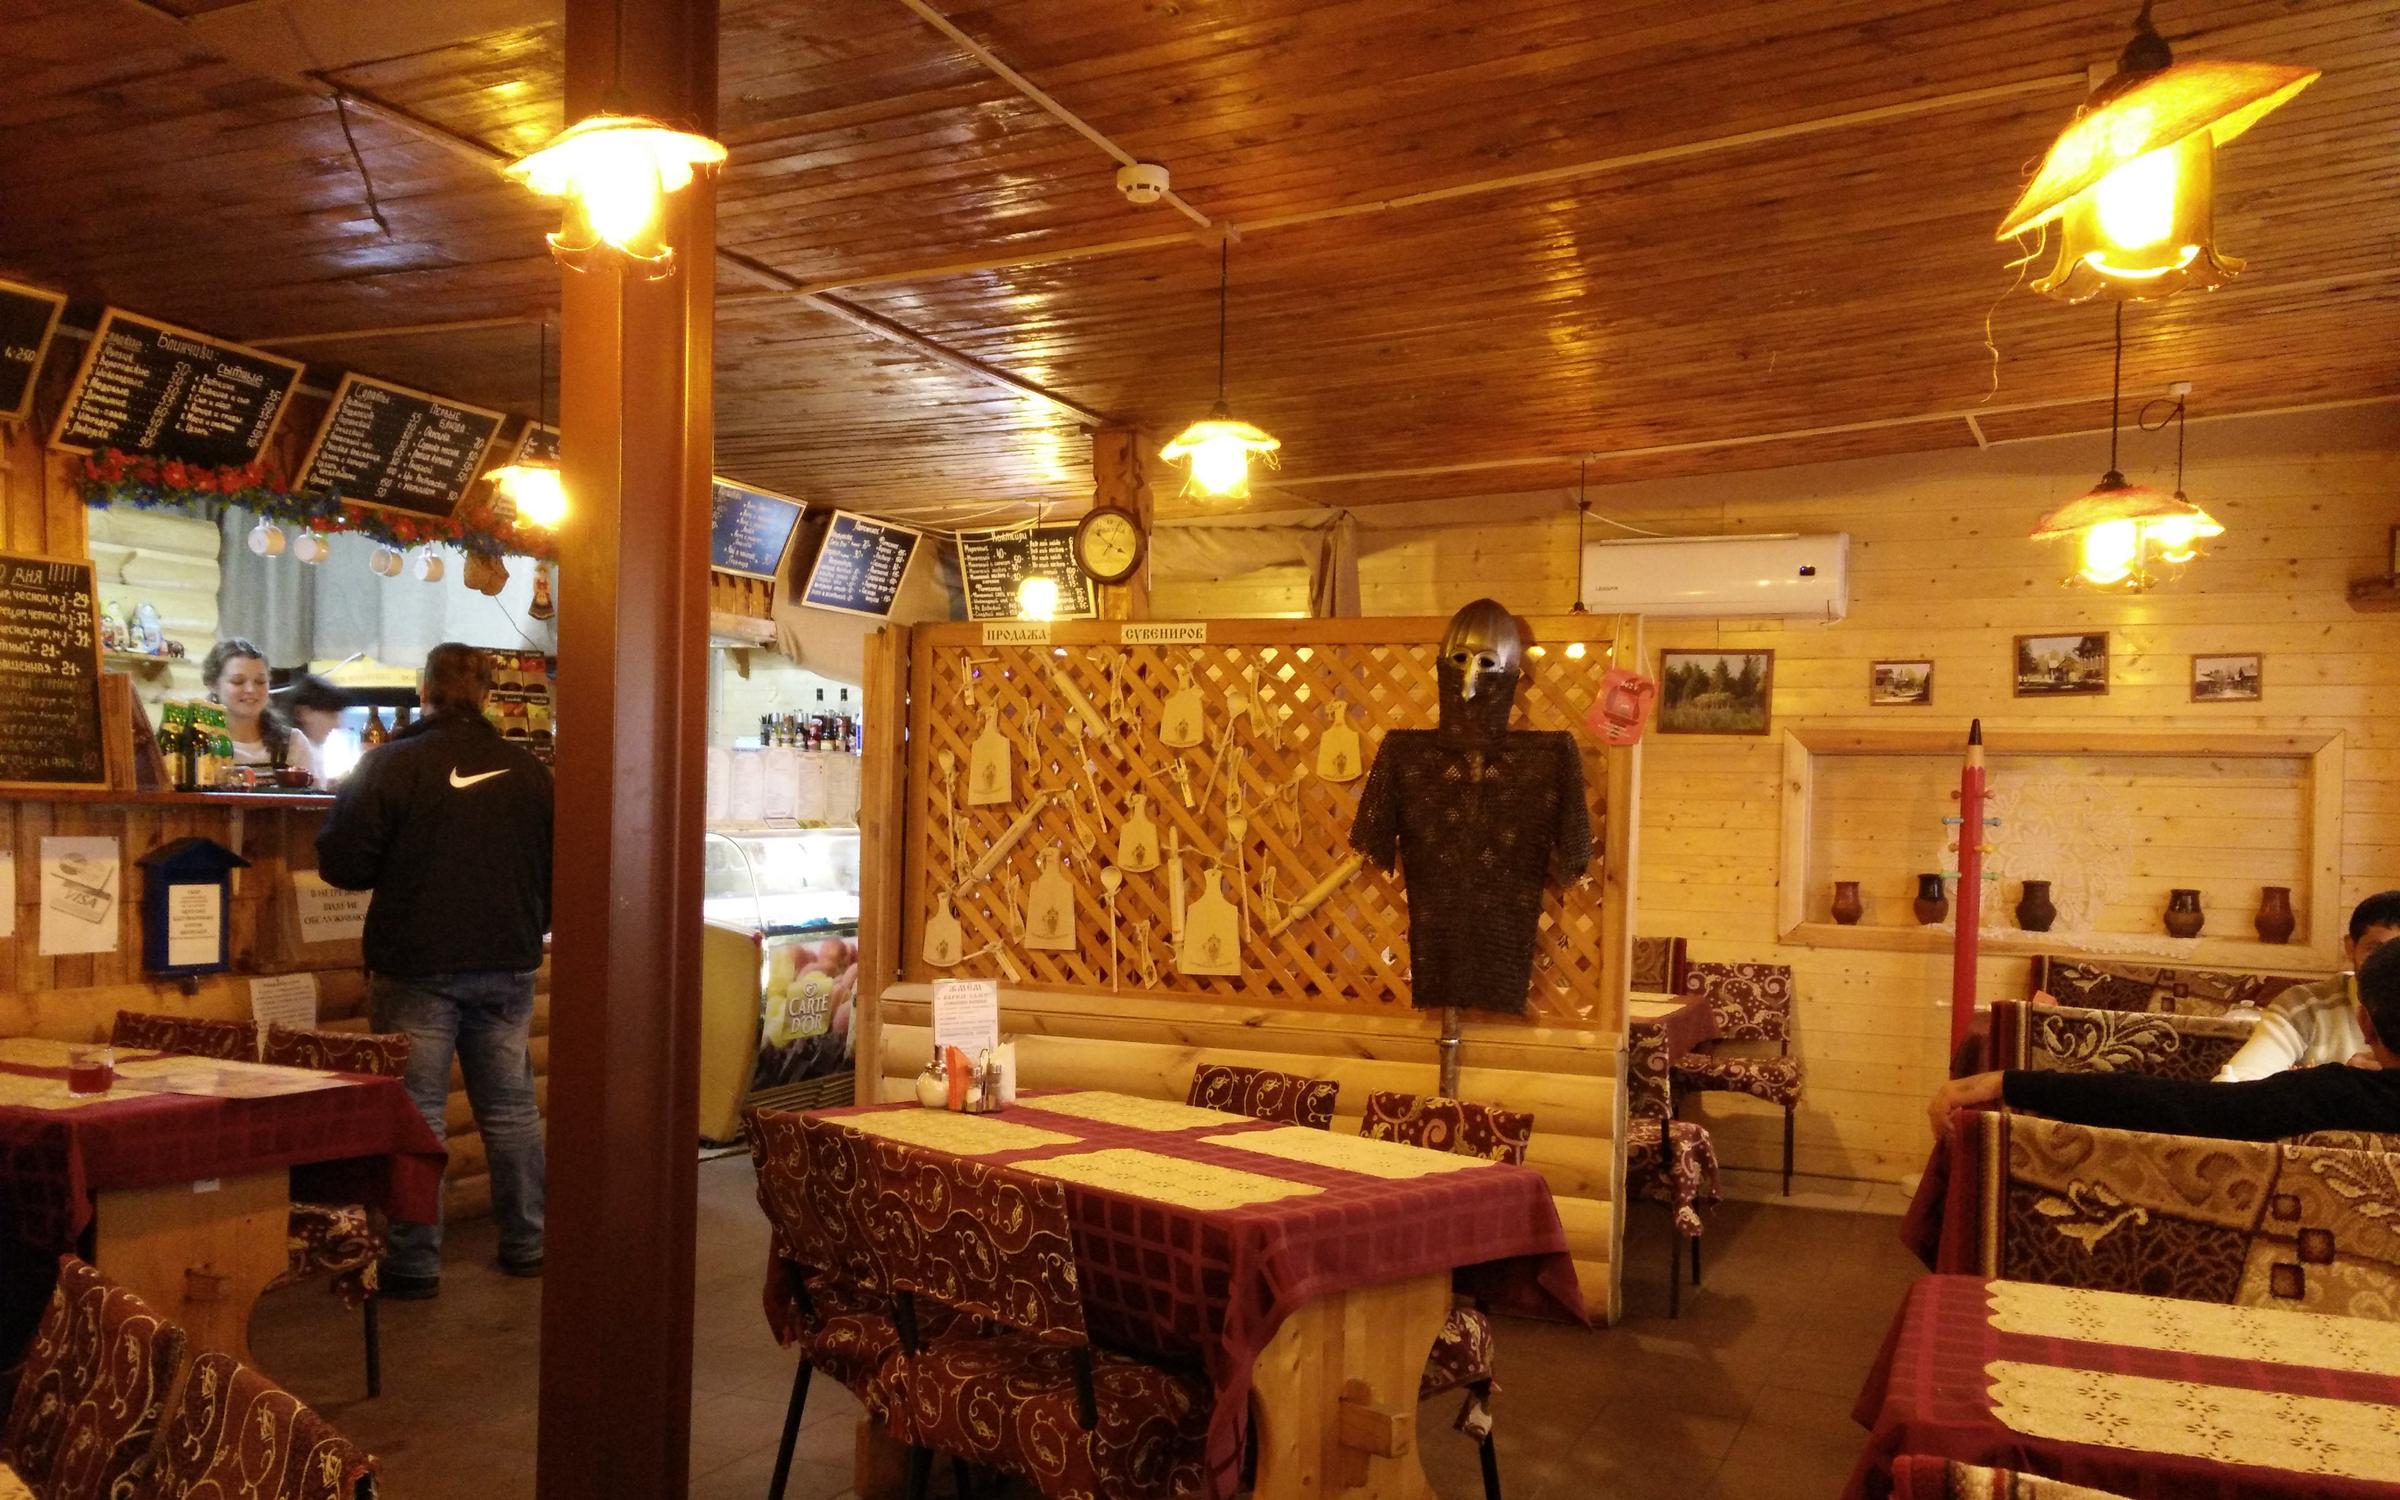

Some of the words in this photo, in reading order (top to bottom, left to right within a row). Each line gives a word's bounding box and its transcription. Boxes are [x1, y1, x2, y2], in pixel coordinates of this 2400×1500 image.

[987, 629, 1047, 642] ПРОДАЖА
[1125, 627, 1204, 642] СУВЕНИРОВ
[788, 994, 829, 1016] CARTE
[791, 1013, 823, 1034] D'OR
